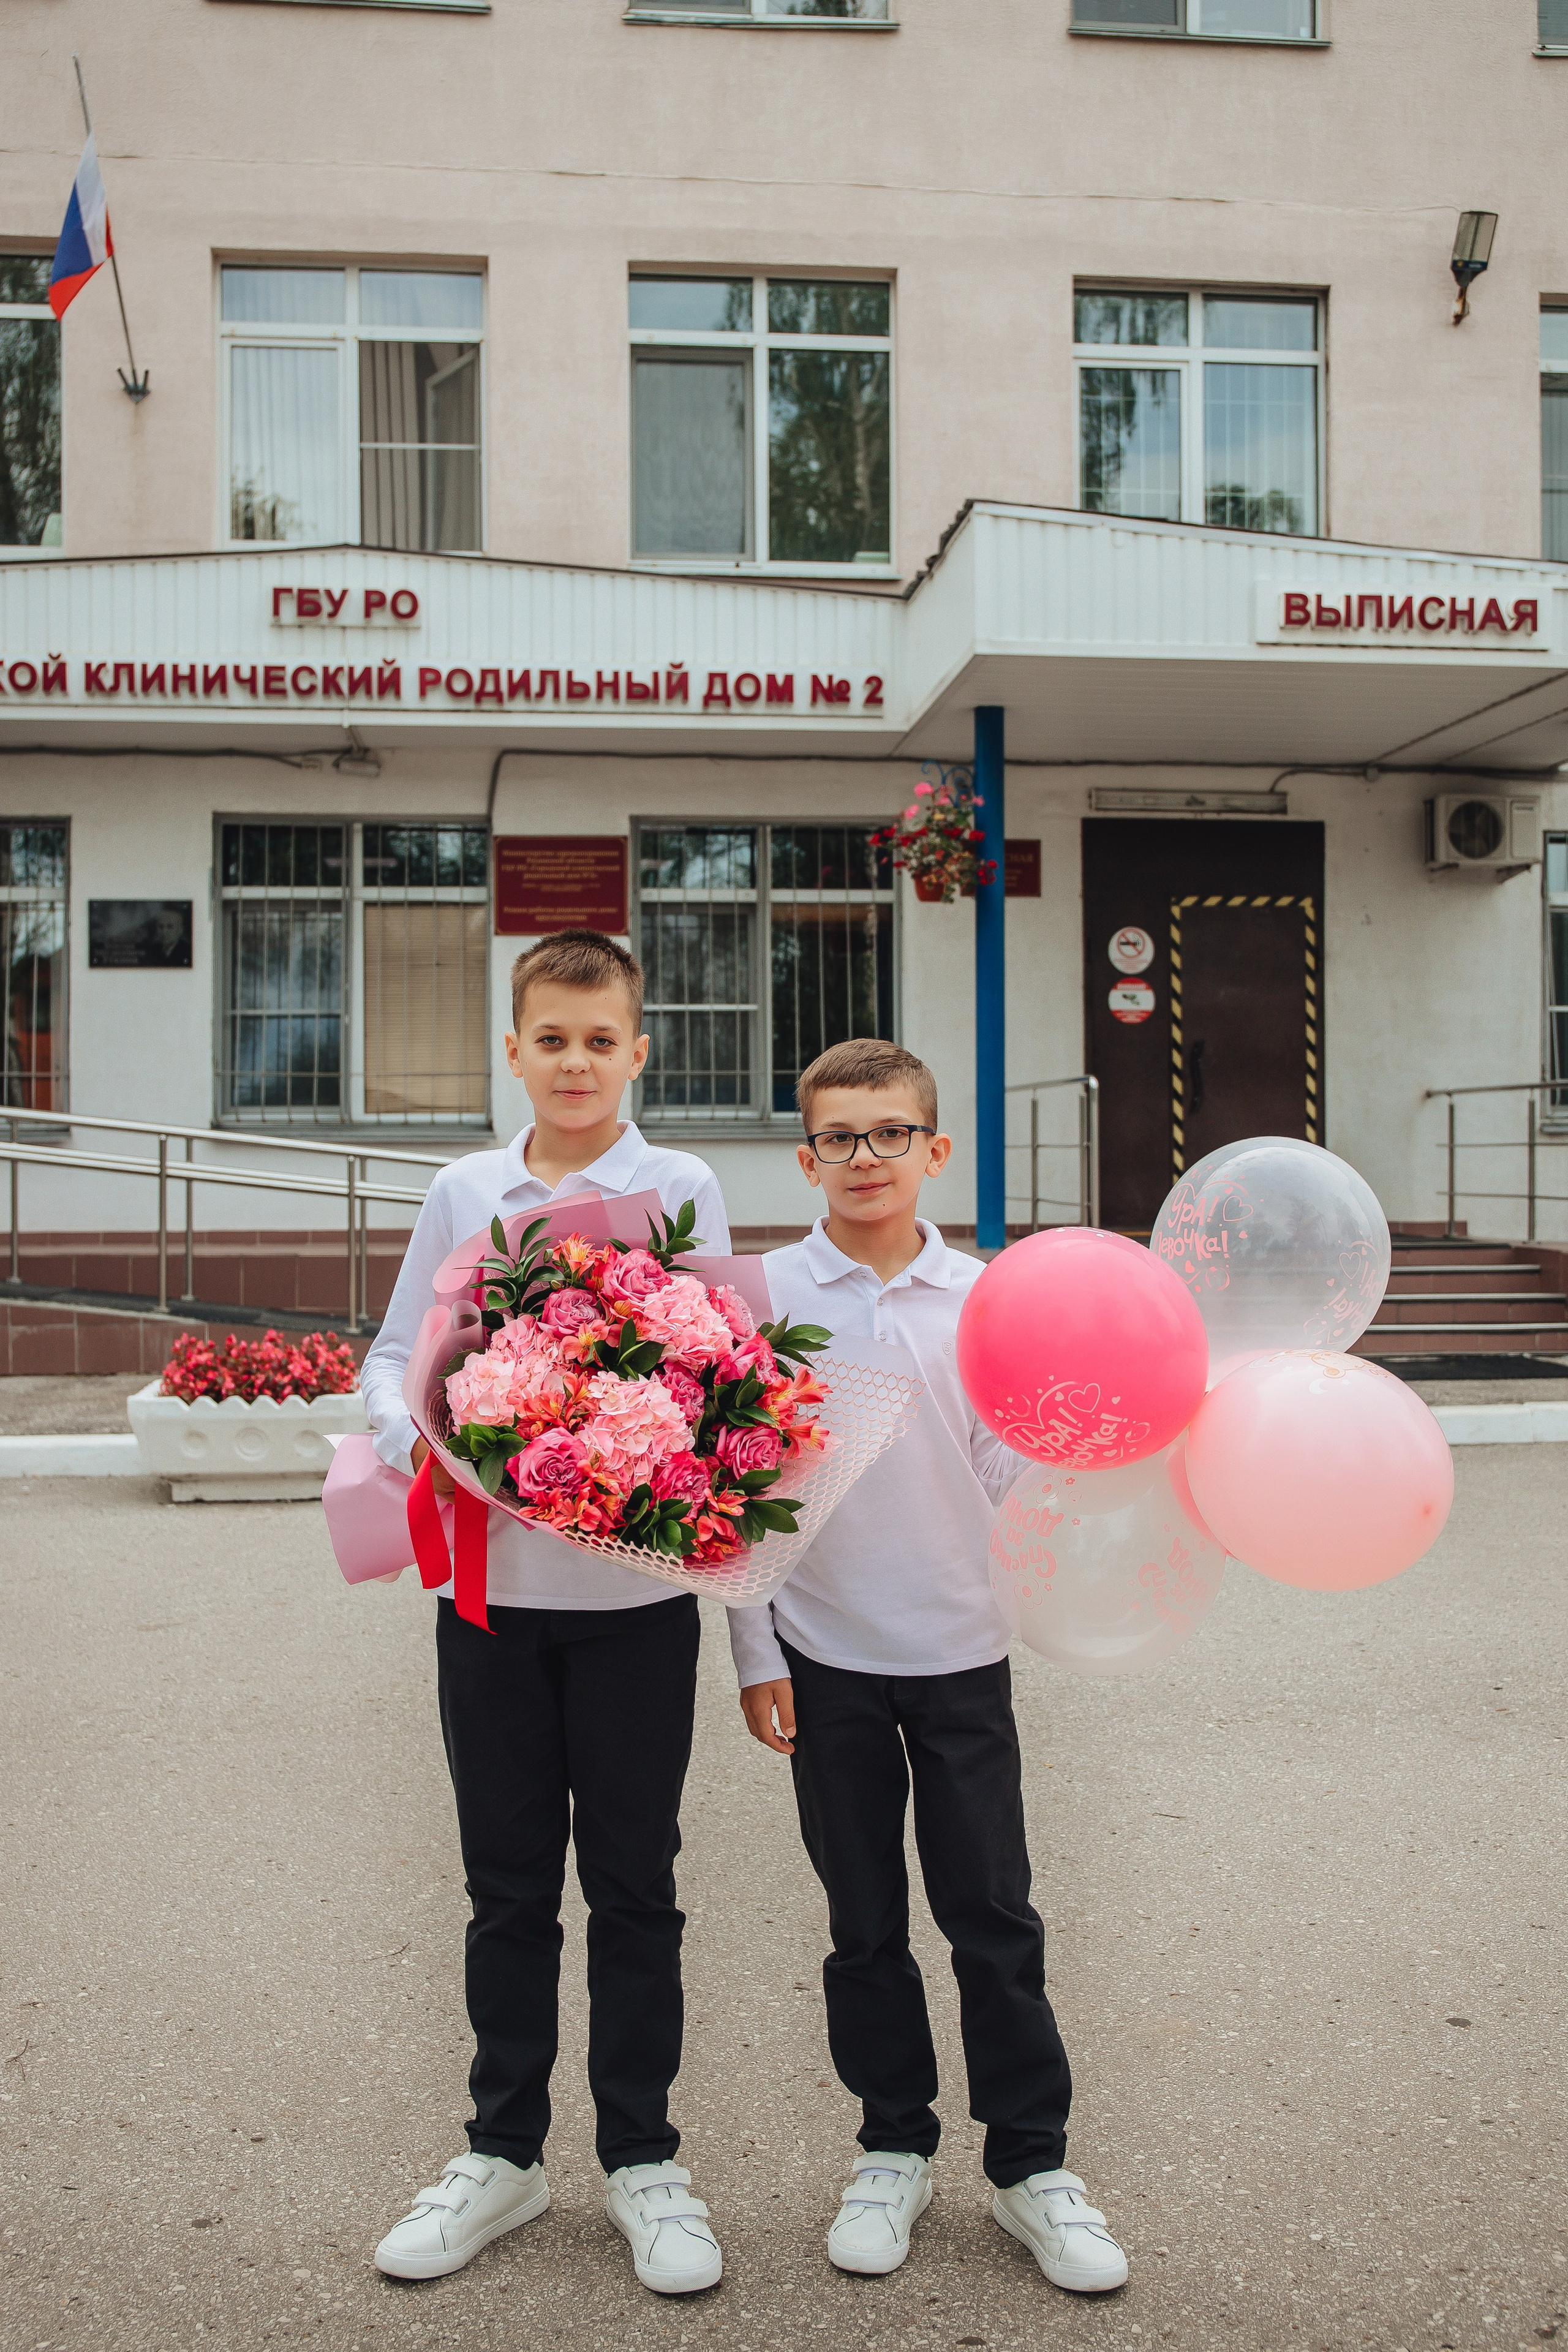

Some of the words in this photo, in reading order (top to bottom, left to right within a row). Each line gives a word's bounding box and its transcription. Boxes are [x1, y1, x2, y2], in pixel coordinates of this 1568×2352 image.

[273, 587, 349, 620] ГБУ
[364, 589, 419, 620] РО
[1283, 592, 1538, 632] ВЫПИСНАЯ
[85, 658, 402, 698] КЛИНИЧЕСКИЙ
[418, 663, 689, 706] РОДИЛЬНЫЙ
[703, 672, 794, 709] ДОМ
[864, 675, 884, 705] 2
